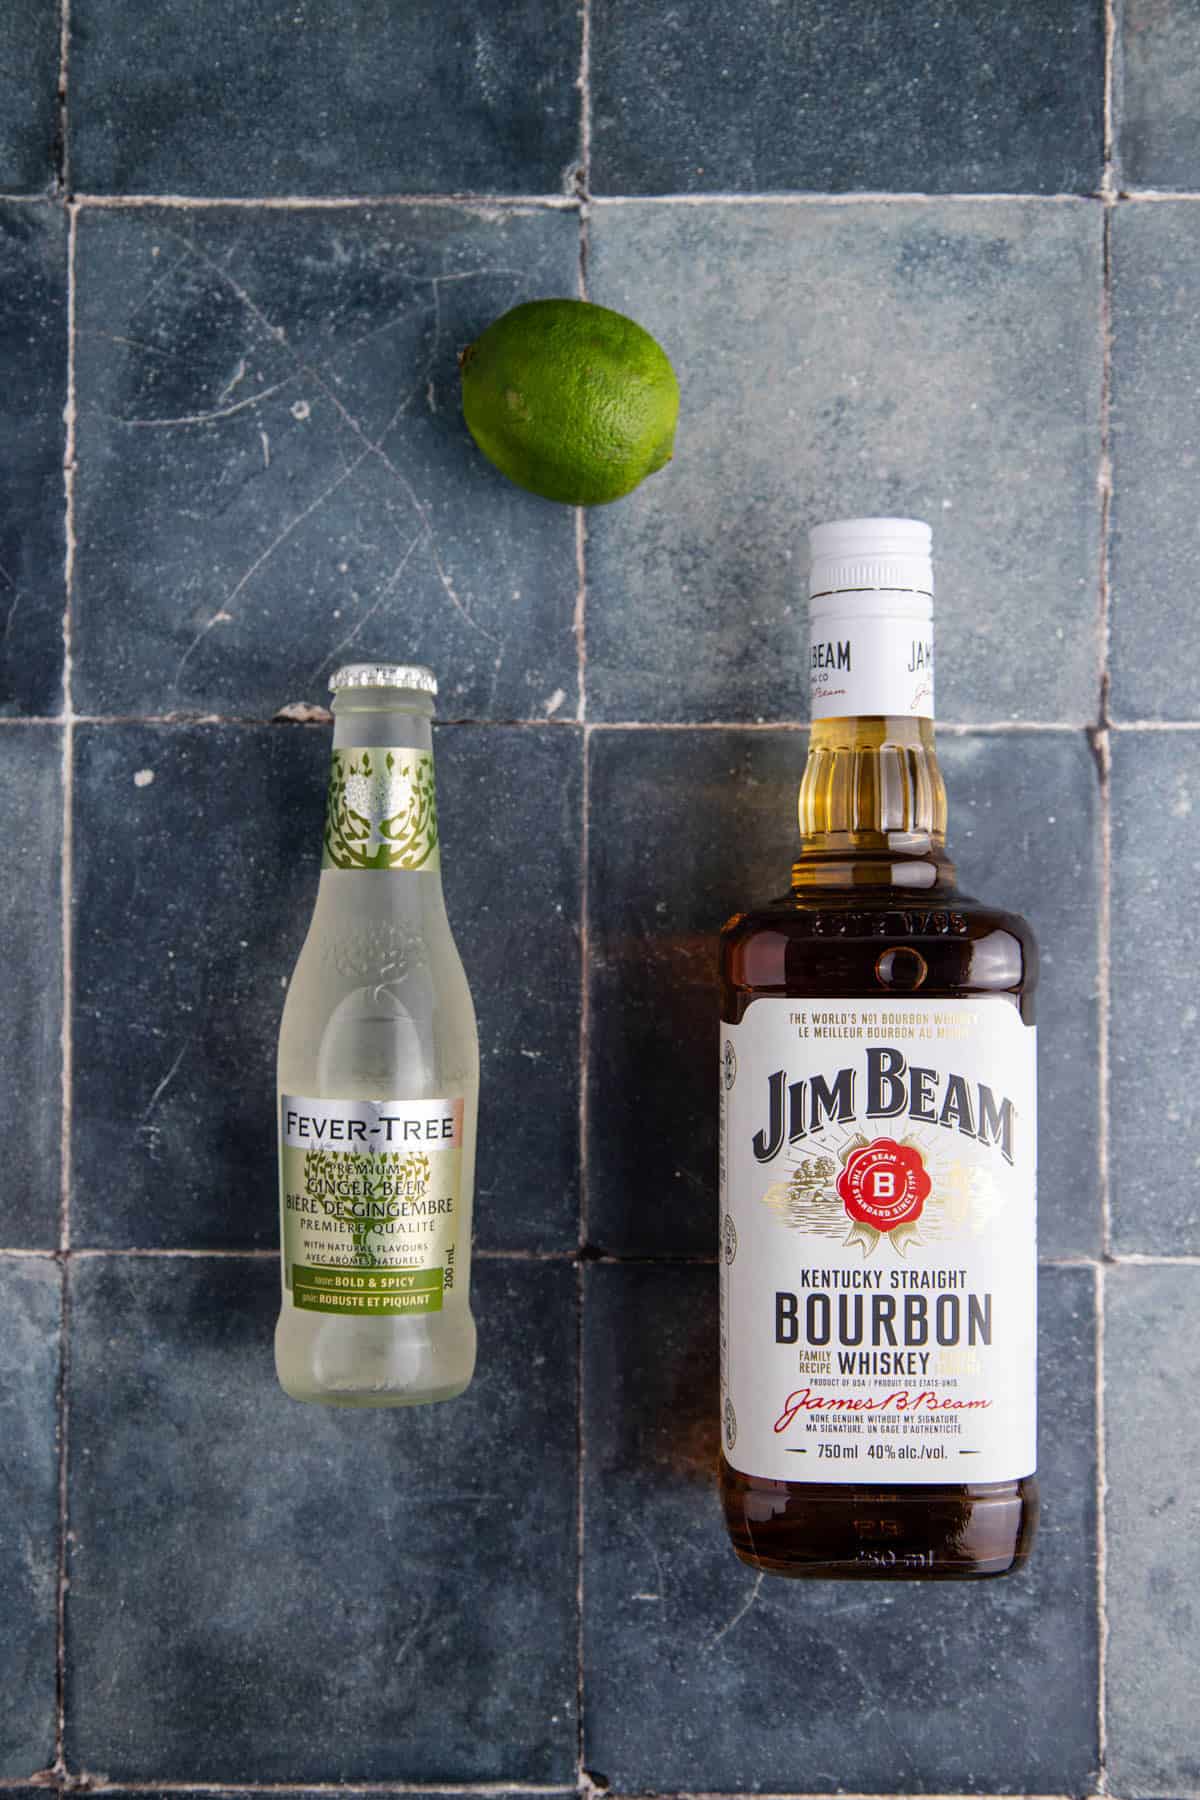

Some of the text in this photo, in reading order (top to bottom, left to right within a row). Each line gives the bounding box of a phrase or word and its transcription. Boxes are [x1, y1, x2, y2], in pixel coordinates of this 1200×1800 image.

[789, 1013, 807, 1025] THE
[811, 1013, 857, 1025] WORLD'S
[881, 1013, 929, 1025] BOURBON
[798, 1026, 809, 1038] LE
[814, 1026, 863, 1038] MEILLEUR
[867, 1026, 915, 1039] BOURBON
[752, 1068, 857, 1164] JIM
[864, 1047, 1015, 1167] BEAM
[286, 1111, 455, 1142] FEVER-TREE
[871, 1153, 897, 1162] BEAM
[328, 1163, 401, 1176] PREMIUM
[307, 1178, 427, 1196] GINGER BEER
[872, 1171, 895, 1198] B
[324, 1200, 345, 1216] DE
[352, 1198, 454, 1217] GINGEMBRE
[303, 1240, 325, 1250] WITH
[377, 1242, 429, 1253] FLAVOURS
[306, 1252, 327, 1263] AVEC
[335, 1276, 366, 1287] BOLD
[368, 1277, 377, 1288] &
[380, 1276, 416, 1288] SPICY
[443, 1267, 454, 1290] 200
[799, 1269, 967, 1290] KENTUCKY STRAIGHT
[319, 1294, 365, 1306] ROBUSTE
[367, 1297, 379, 1307] ET
[380, 1294, 431, 1308] PIQUANT
[775, 1291, 992, 1347] BOURBON
[799, 1350, 832, 1362] FAMILY
[799, 1363, 832, 1375] RECIPE
[837, 1351, 930, 1376] WHISKEY
[809, 1378, 840, 1387] PRODUCT
[842, 1378, 849, 1387] OF
[852, 1378, 866, 1387] USA
[874, 1378, 902, 1388] PRODUIT
[774, 1387, 878, 1434] James
[911, 1391, 992, 1410] Beam
[810, 1413, 830, 1424] NONE
[832, 1414, 864, 1424] GENUINE
[867, 1414, 901, 1424] WITHOUT
[904, 1415, 915, 1424] MY
[806, 1423, 818, 1433] MA
[867, 1424, 878, 1434] UN
[880, 1424, 899, 1434] GAGE
